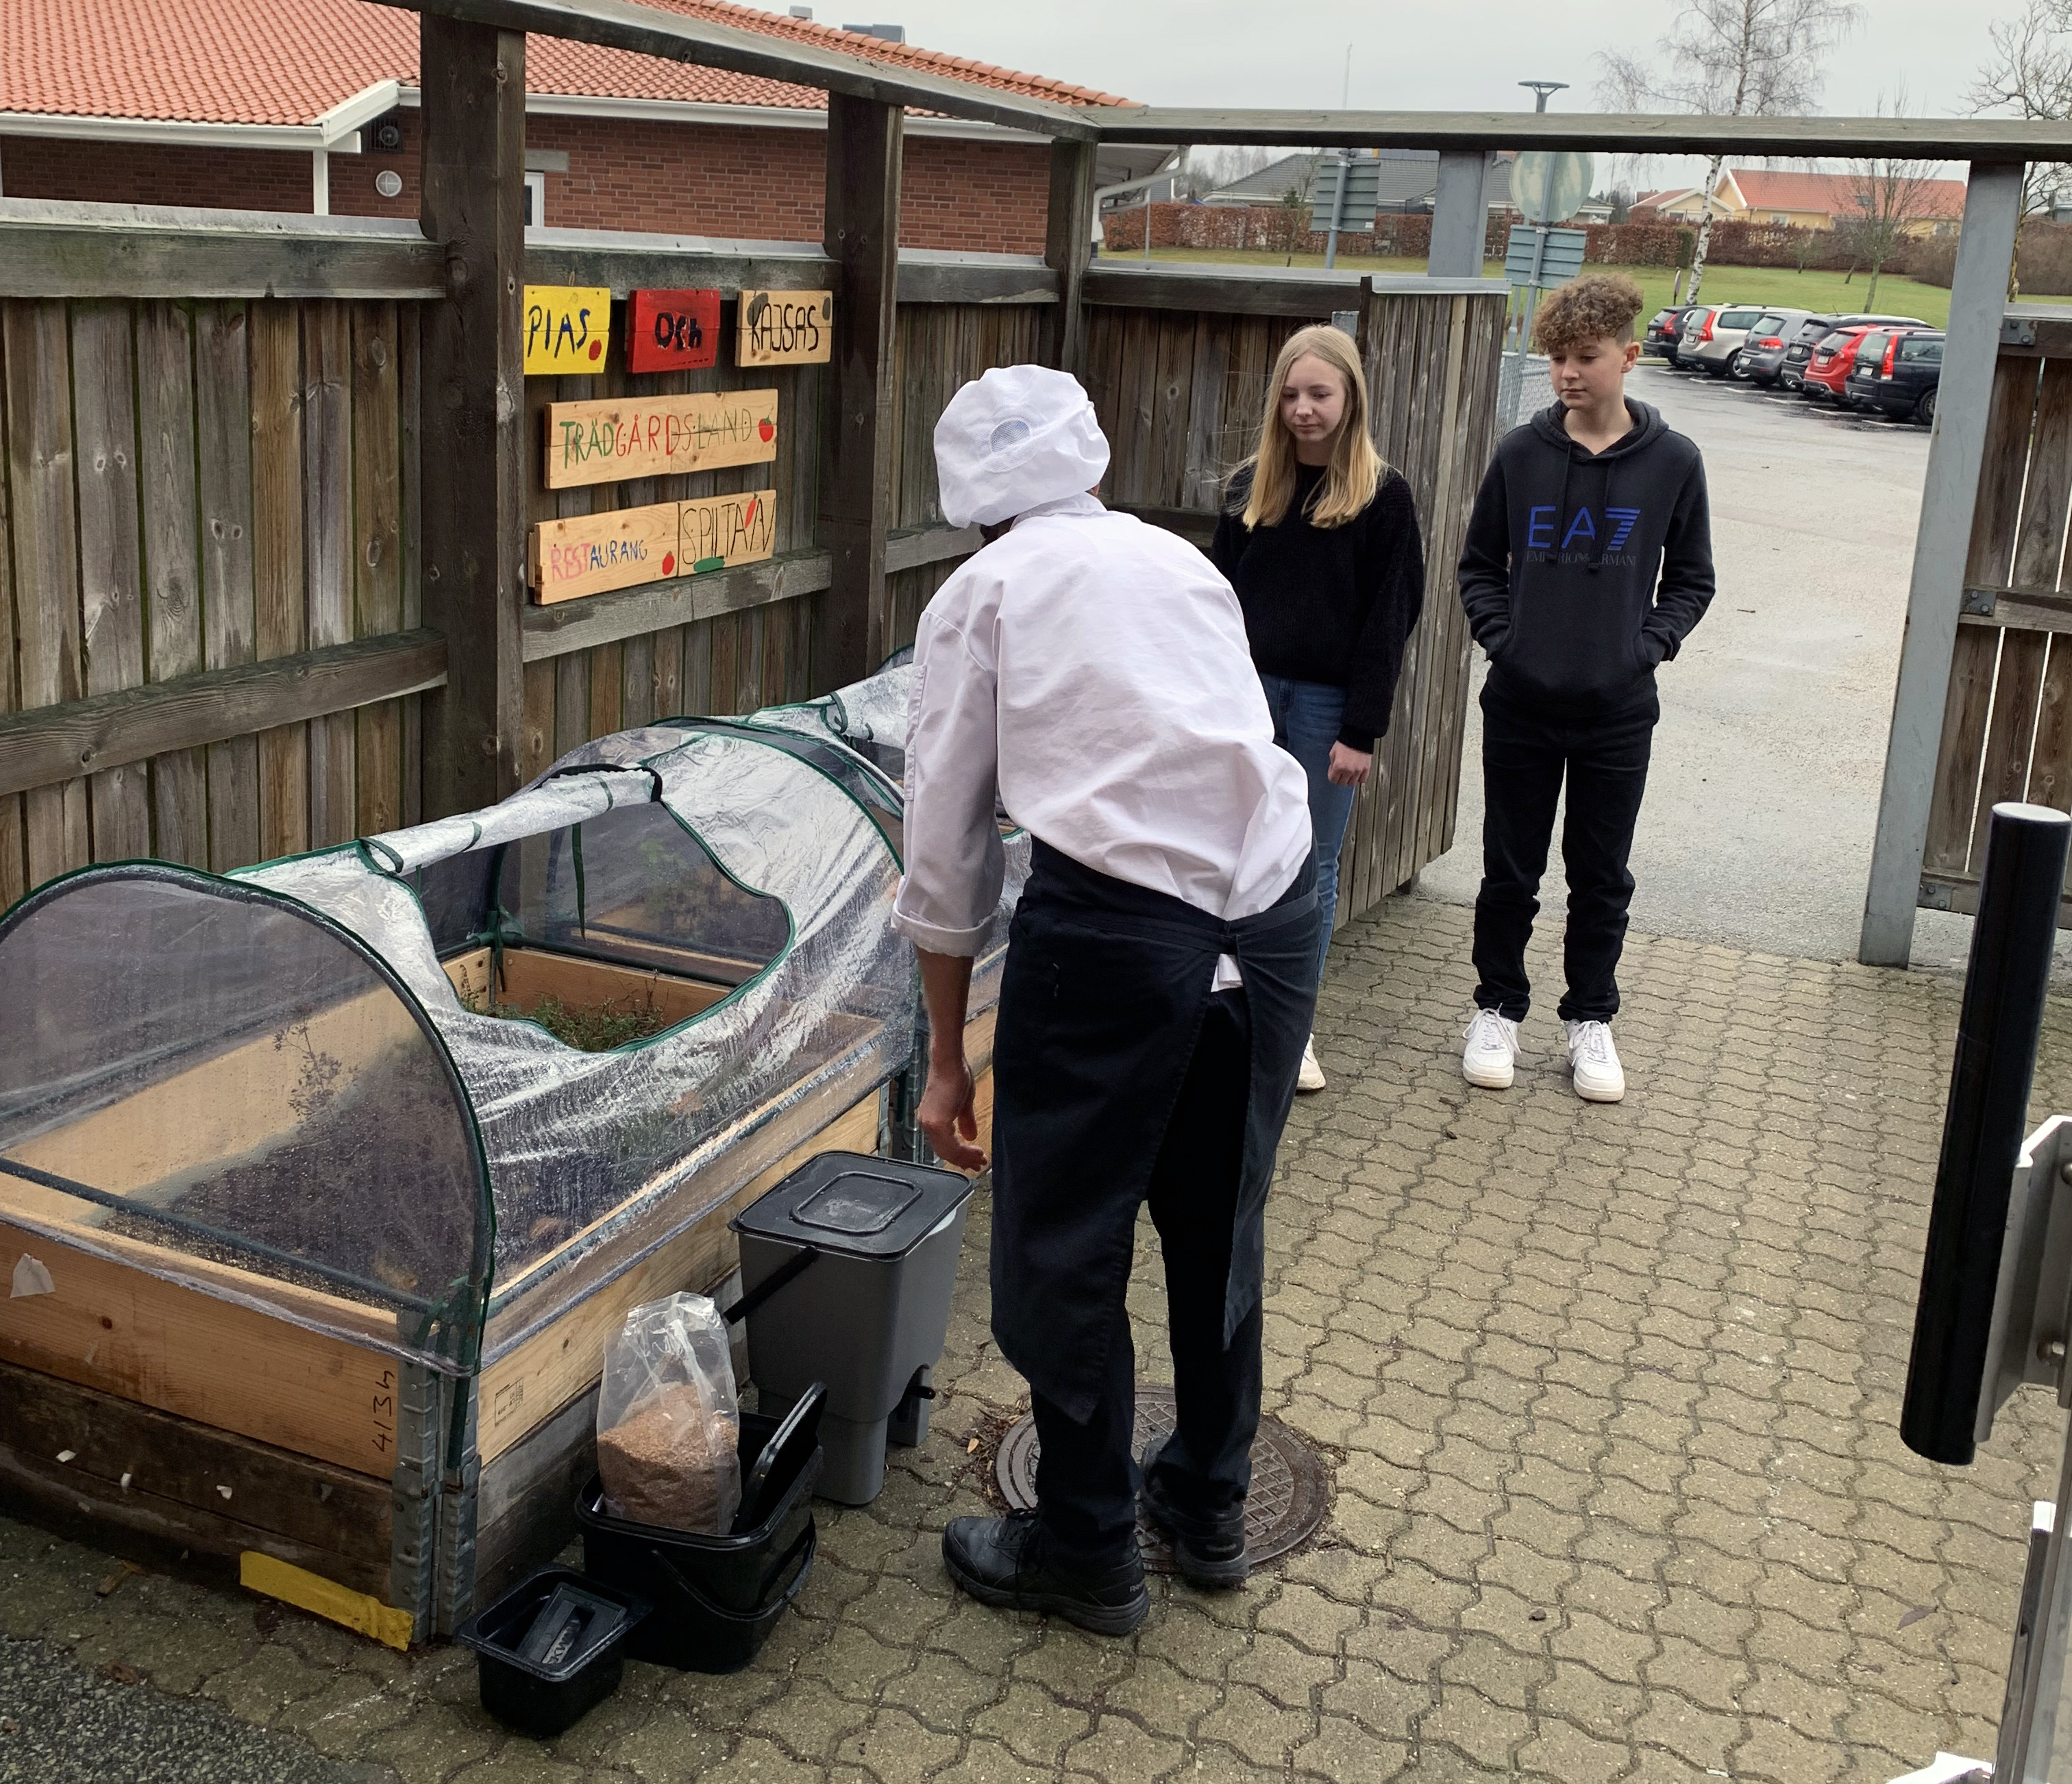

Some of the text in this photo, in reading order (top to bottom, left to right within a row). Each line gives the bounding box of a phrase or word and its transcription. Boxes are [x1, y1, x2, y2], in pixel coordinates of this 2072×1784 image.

[527, 305, 591, 359] PIAS
[751, 303, 819, 352] KAJSAS
[559, 408, 752, 469] TRÄDGÅRDSLAND
[551, 498, 776, 583] RESTAURANG SPILTAN
[1527, 505, 1642, 551] EA7
